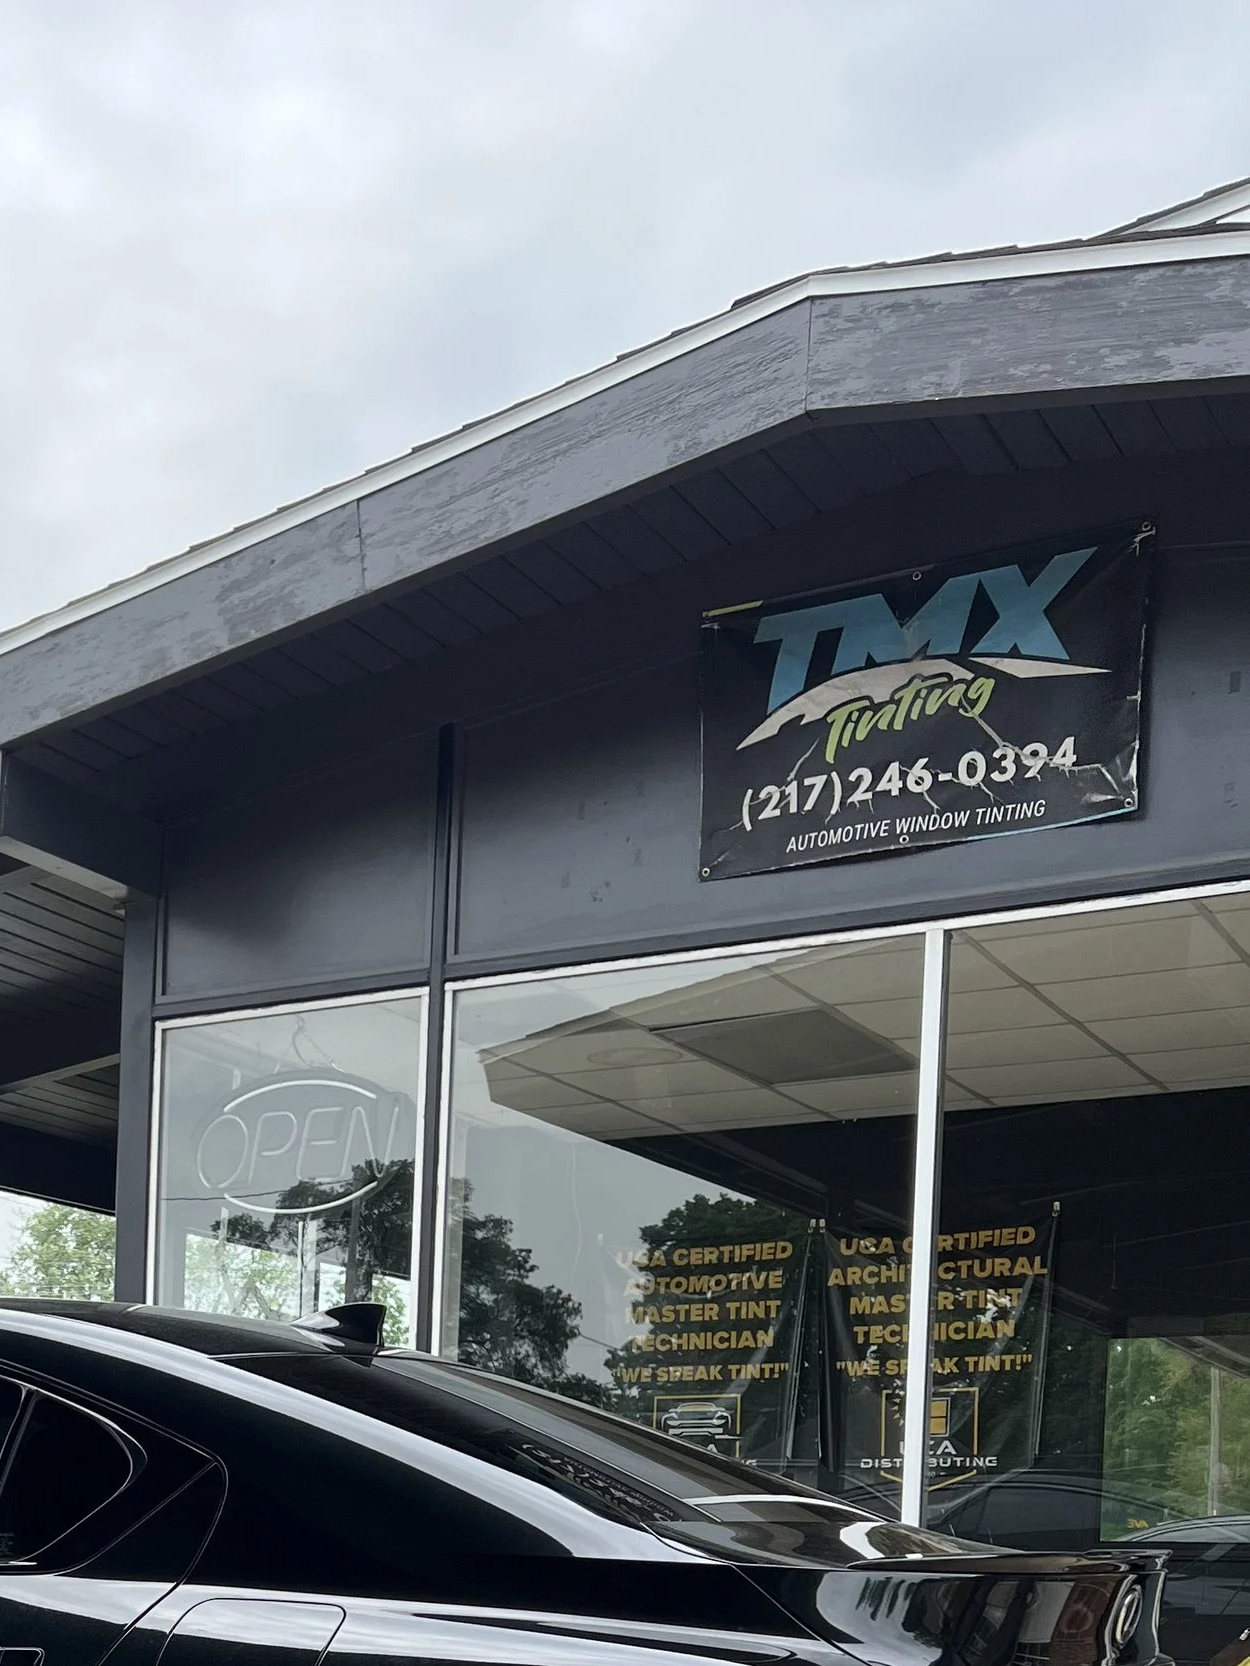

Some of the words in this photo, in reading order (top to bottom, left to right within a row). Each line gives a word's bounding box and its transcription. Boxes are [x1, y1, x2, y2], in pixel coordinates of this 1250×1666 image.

[753, 547, 1098, 715] TMX
[826, 677, 995, 764] Tinting
[742, 736, 1077, 831] (217)246-0394
[786, 820, 891, 853] AUTOMOTIVE
[895, 810, 969, 835] WINDOW
[975, 800, 1046, 825] TINTING
[197, 1106, 399, 1189] OPEN
[903, 1226, 1036, 1254] CRTIFIED
[673, 1241, 793, 1266] CERTIFIED
[623, 1270, 783, 1295] AUTOMOTIVE
[827, 1255, 1048, 1287] ARCHICTURAL
[625, 1303, 719, 1325] MASTER
[726, 1300, 781, 1320] TINT
[850, 1290, 954, 1315] MASR
[628, 1330, 775, 1351] TECHNICIAN
[657, 1365, 723, 1382] SPEAK
[728, 1363, 789, 1380] TINT!"
[836, 1360, 880, 1377] "WE
[965, 1354, 1033, 1372] TINT!"
[860, 1456, 998, 1469] DISTBUTING
